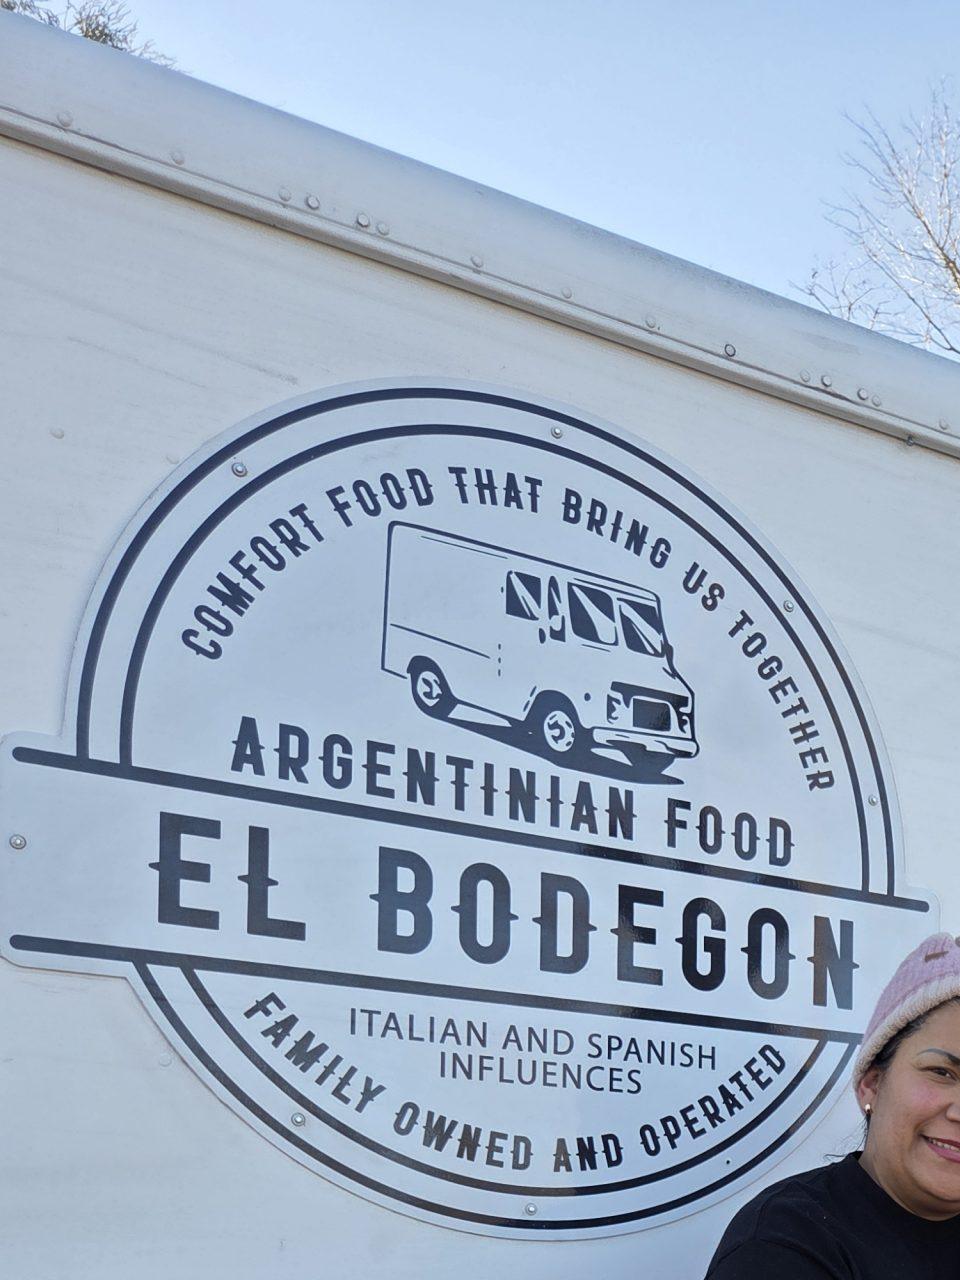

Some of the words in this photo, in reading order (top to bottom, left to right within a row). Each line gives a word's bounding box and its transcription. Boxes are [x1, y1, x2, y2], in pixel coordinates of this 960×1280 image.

[182, 503, 324, 660] COMFORT
[325, 468, 434, 527] FOOD
[448, 467, 542, 513] THAT
[562, 487, 672, 569] BRING
[682, 562, 725, 611] US
[728, 609, 834, 791] TOGETHER
[230, 716, 637, 841] ARGENTINIAN
[664, 798, 794, 867] FOOD
[149, 811, 306, 941] EL
[369, 845, 859, 1010] BODEGON
[244, 991, 388, 1114] FAMILY
[394, 1101, 533, 1171] OWNED
[553, 1133, 623, 1173] AND
[640, 1043, 786, 1157] OPERATED
[350, 1007, 487, 1048] ITALIAN
[502, 1023, 575, 1056] AND
[588, 1033, 717, 1071] SPANISH
[440, 1051, 642, 1094] INFLUENCES
